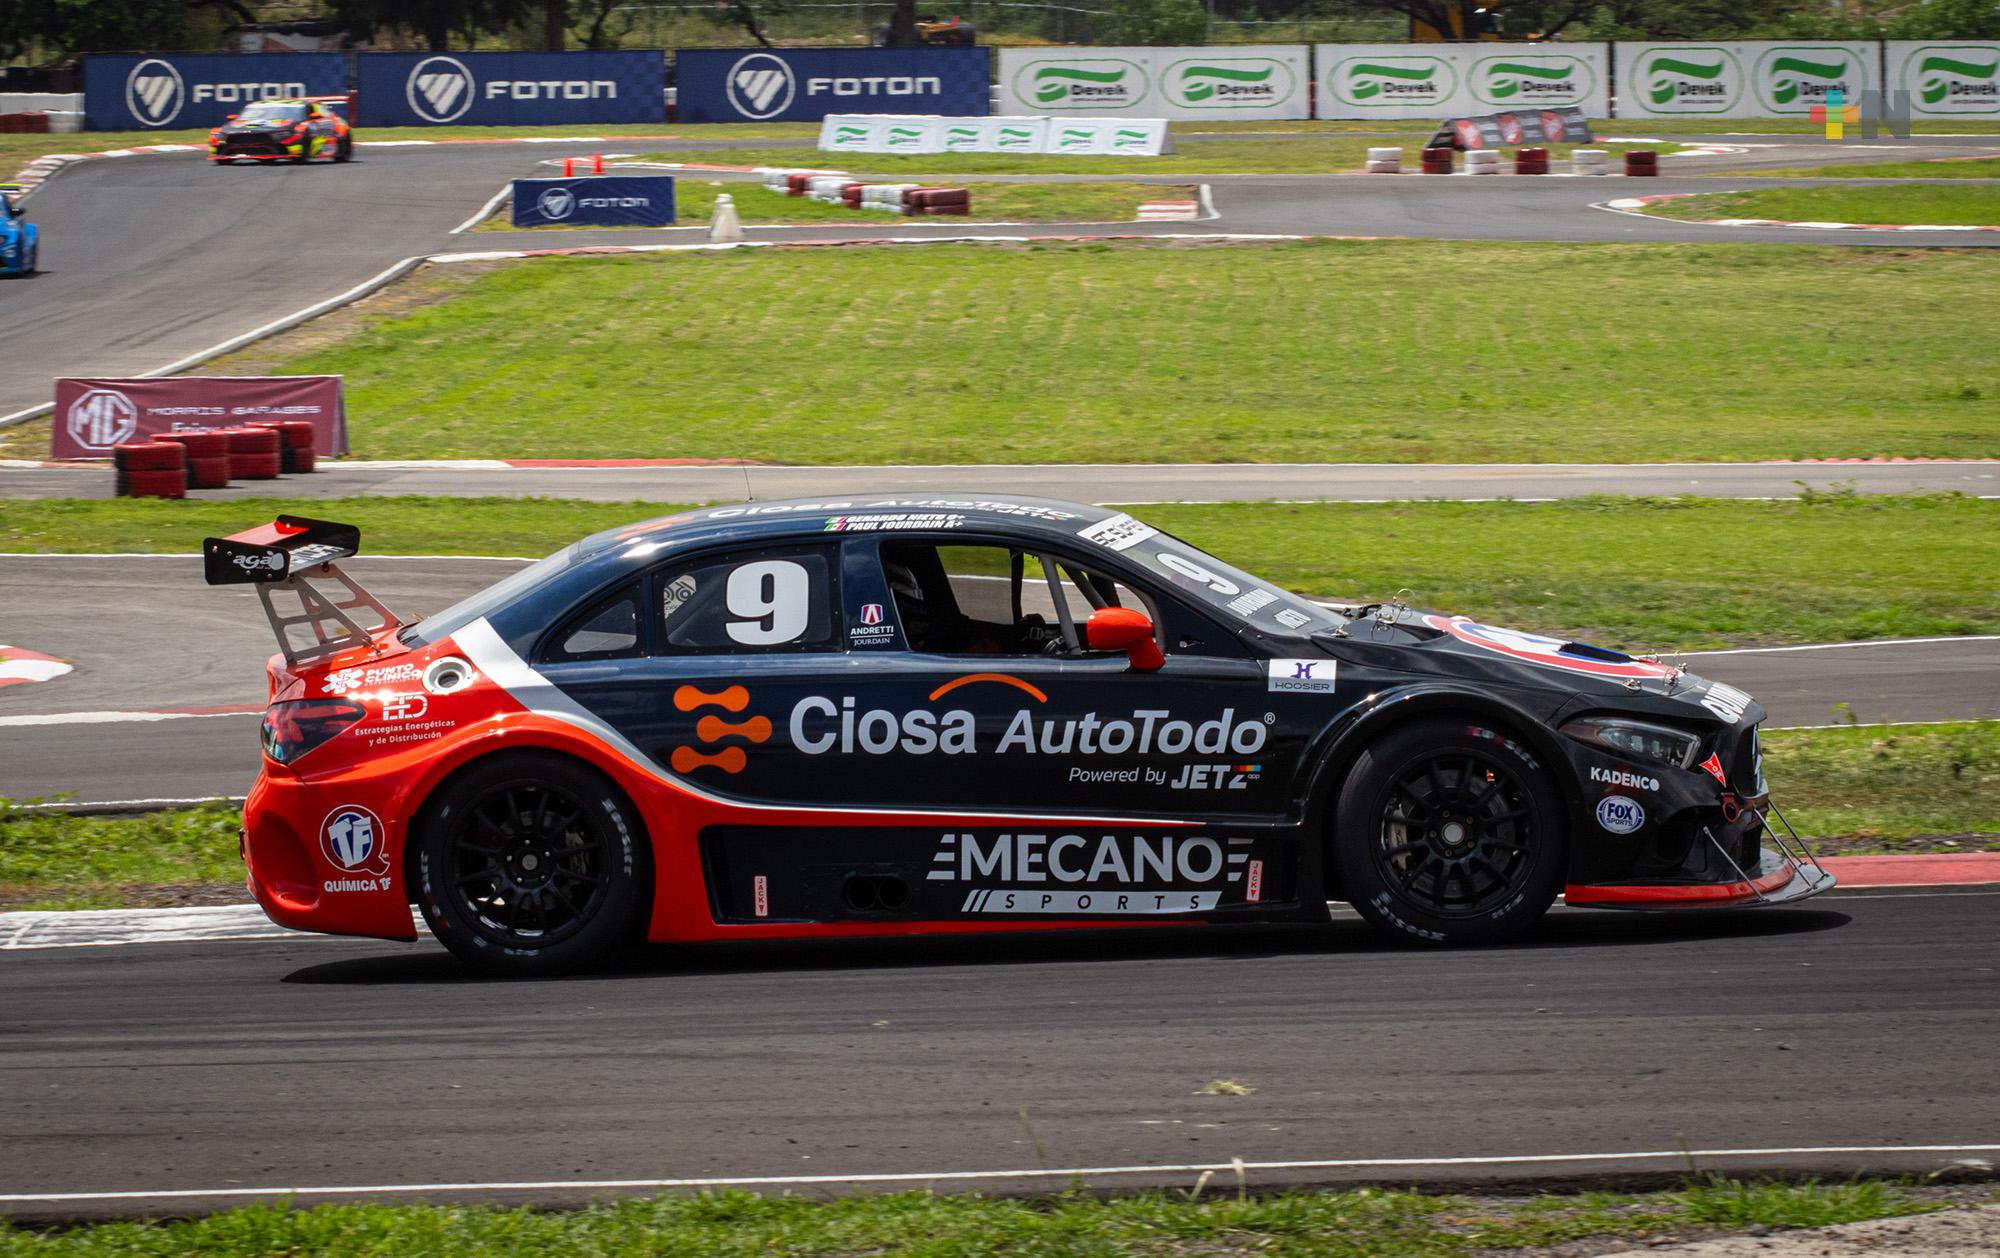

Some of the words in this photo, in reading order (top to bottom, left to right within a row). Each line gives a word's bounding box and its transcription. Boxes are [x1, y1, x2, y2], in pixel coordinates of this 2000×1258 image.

[193, 83, 306, 102] FOTON
[486, 81, 617, 99] FOTON
[807, 77, 941, 96] FOTON
[1070, 84, 1128, 95] Devek
[1217, 83, 1275, 95] Devek
[1383, 82, 1438, 93] Devek
[1520, 80, 1576, 93] Devek
[1677, 81, 1727, 96] Devek
[578, 197, 650, 208] FOTON
[76, 395, 131, 445] MG
[846, 521, 878, 531] PAUL
[879, 520, 944, 530] JOURDAIN
[1157, 553, 1240, 595] 9
[726, 560, 809, 645] 9
[850, 626, 894, 636] ANDRETTI
[853, 637, 891, 646] JOURDAIN
[366, 663, 414, 677] PUNTO
[1275, 682, 1330, 690] HOOSIER
[355, 723, 403, 737] Estrategias
[405, 720, 455, 732] Energéticas
[789, 696, 977, 755] Ciosa
[376, 736, 387, 745] de
[390, 731, 442, 743] Distribución
[1069, 767, 1139, 782] Powered
[1145, 767, 1166, 784] by
[1607, 803, 1633, 821] FOX
[1606, 816, 1633, 827] SPORTS
[324, 877, 378, 893] QUÍMICA
[1005, 893, 1200, 911] SPORTS
